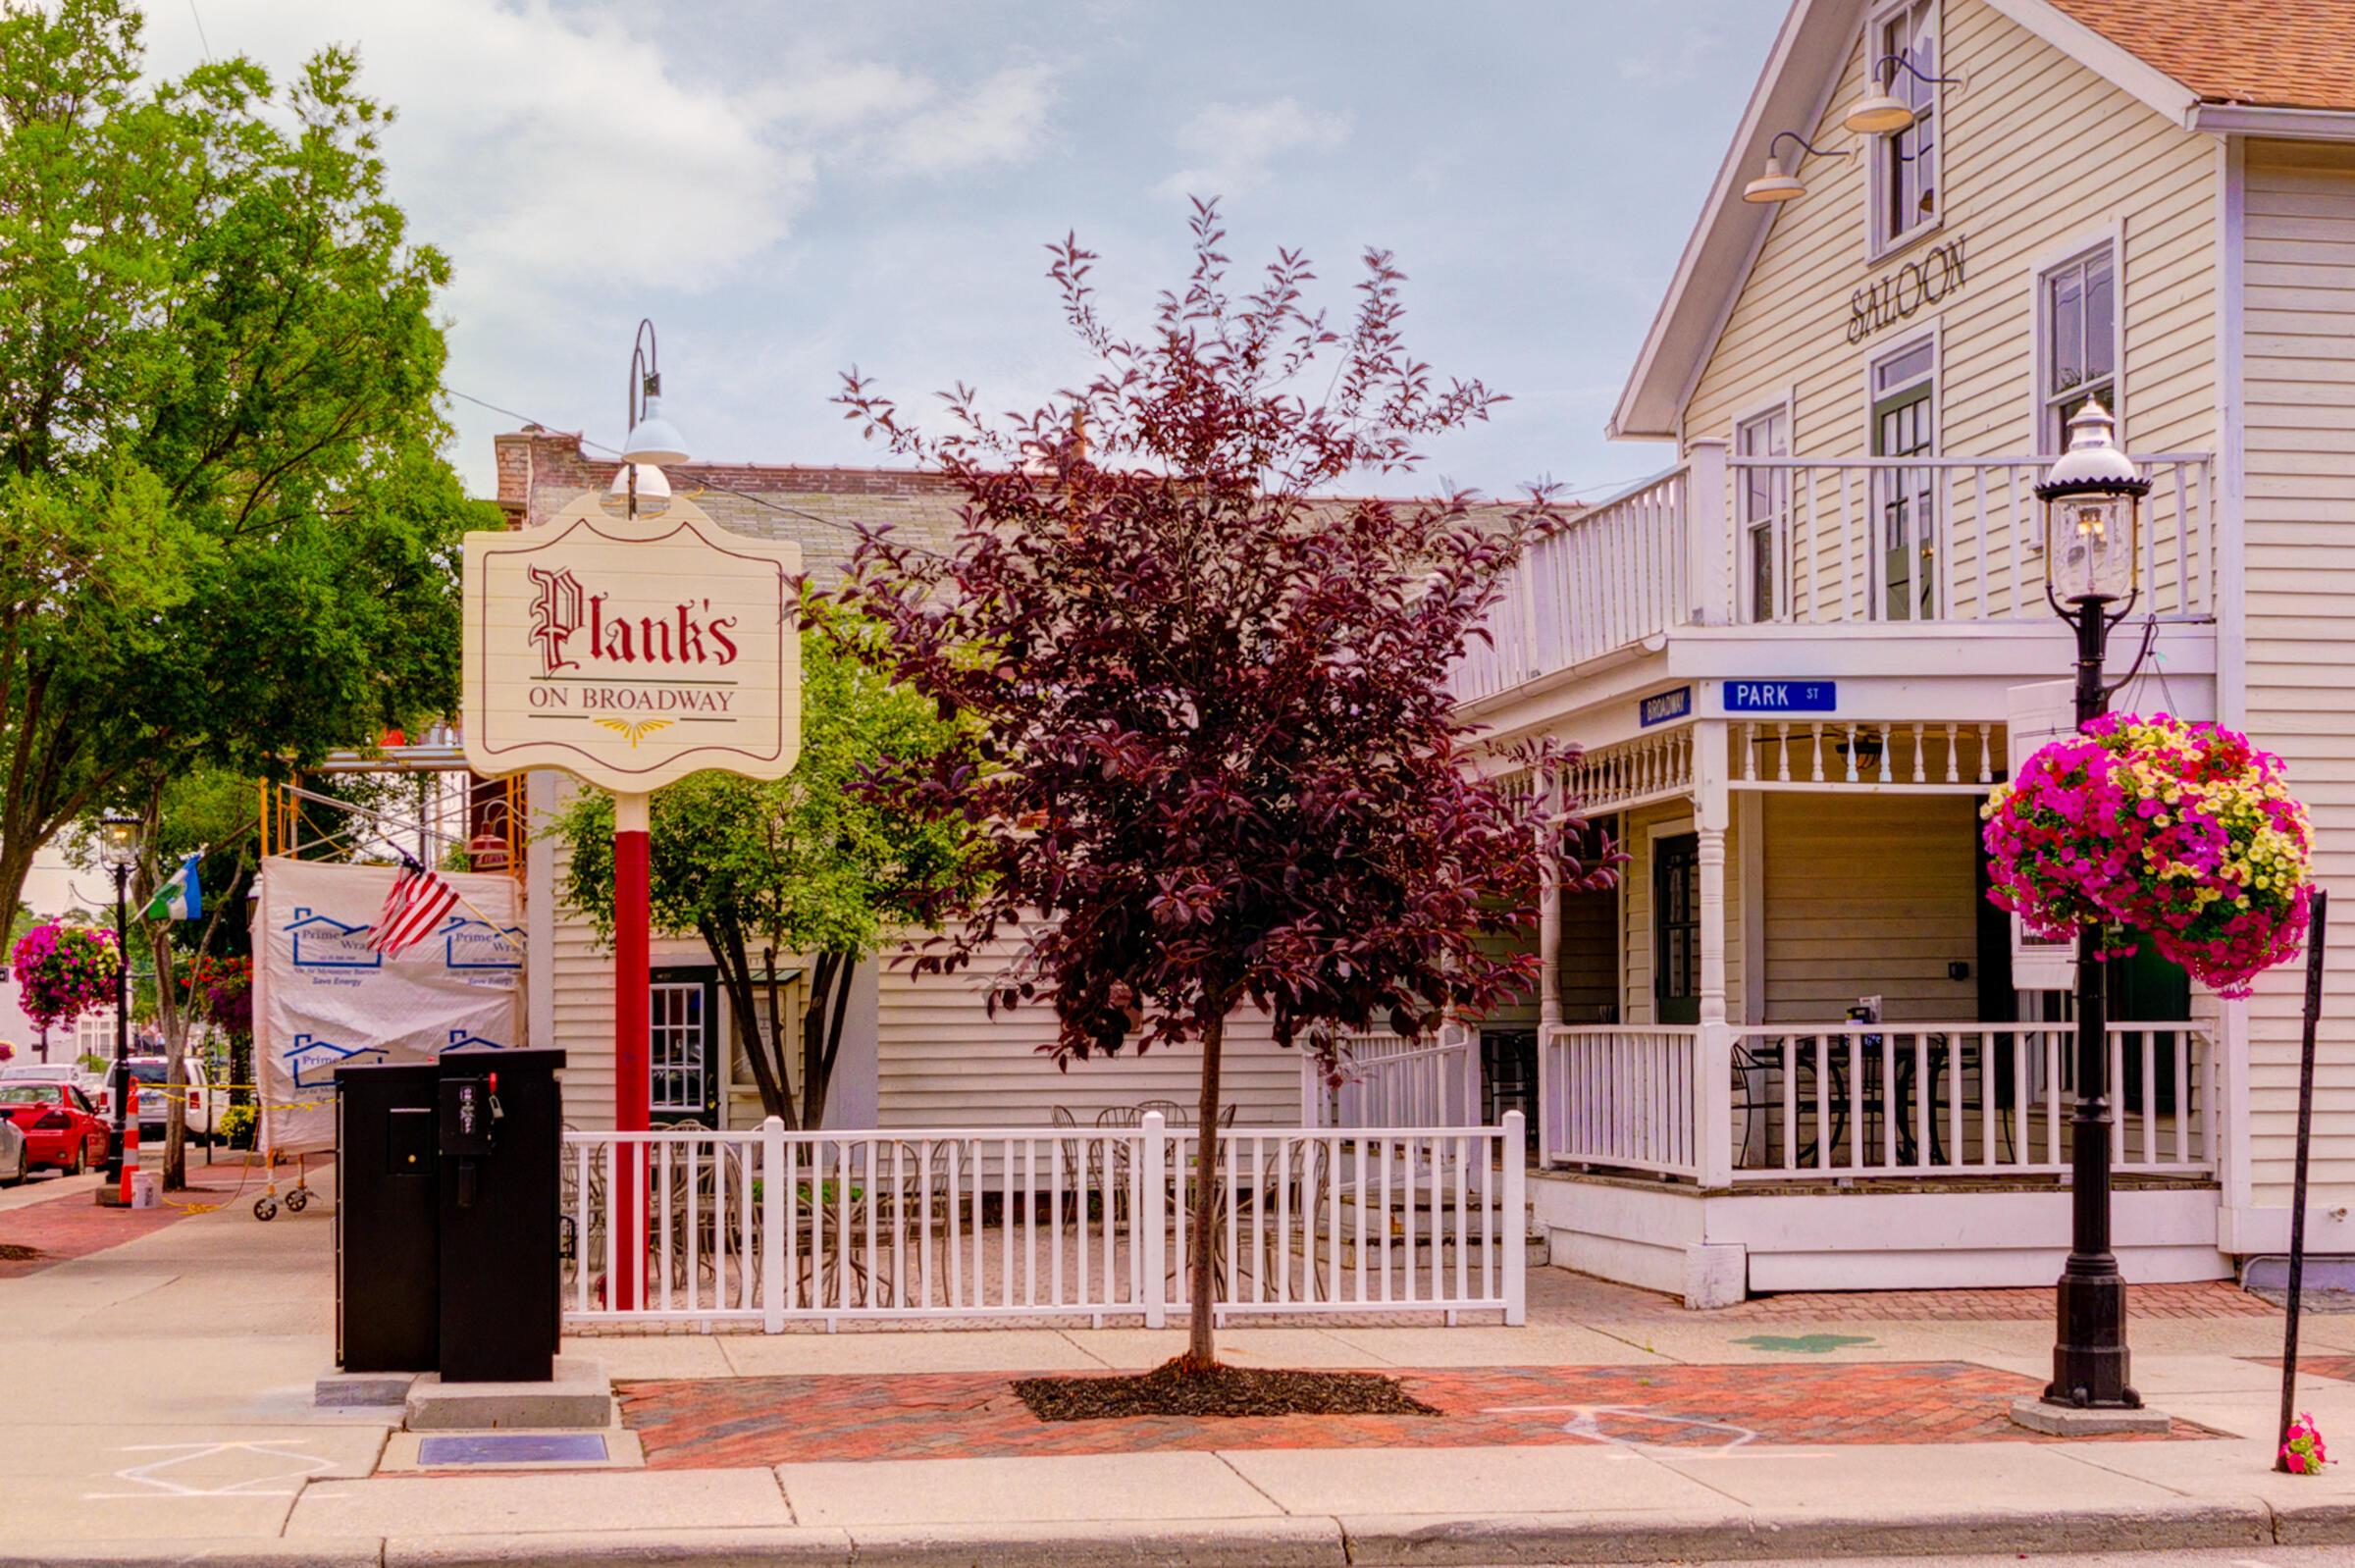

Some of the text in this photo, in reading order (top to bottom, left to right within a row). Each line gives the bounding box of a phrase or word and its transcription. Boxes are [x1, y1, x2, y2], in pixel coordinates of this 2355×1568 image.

[1847, 234, 1965, 345] SALOON
[528, 563, 738, 680] Plank's
[529, 687, 735, 712] ON BROADWAY
[1647, 690, 1686, 722] BROADWAY
[1737, 684, 1819, 706] PARK ST
[302, 928, 339, 940] Prime
[455, 932, 493, 943] Prime
